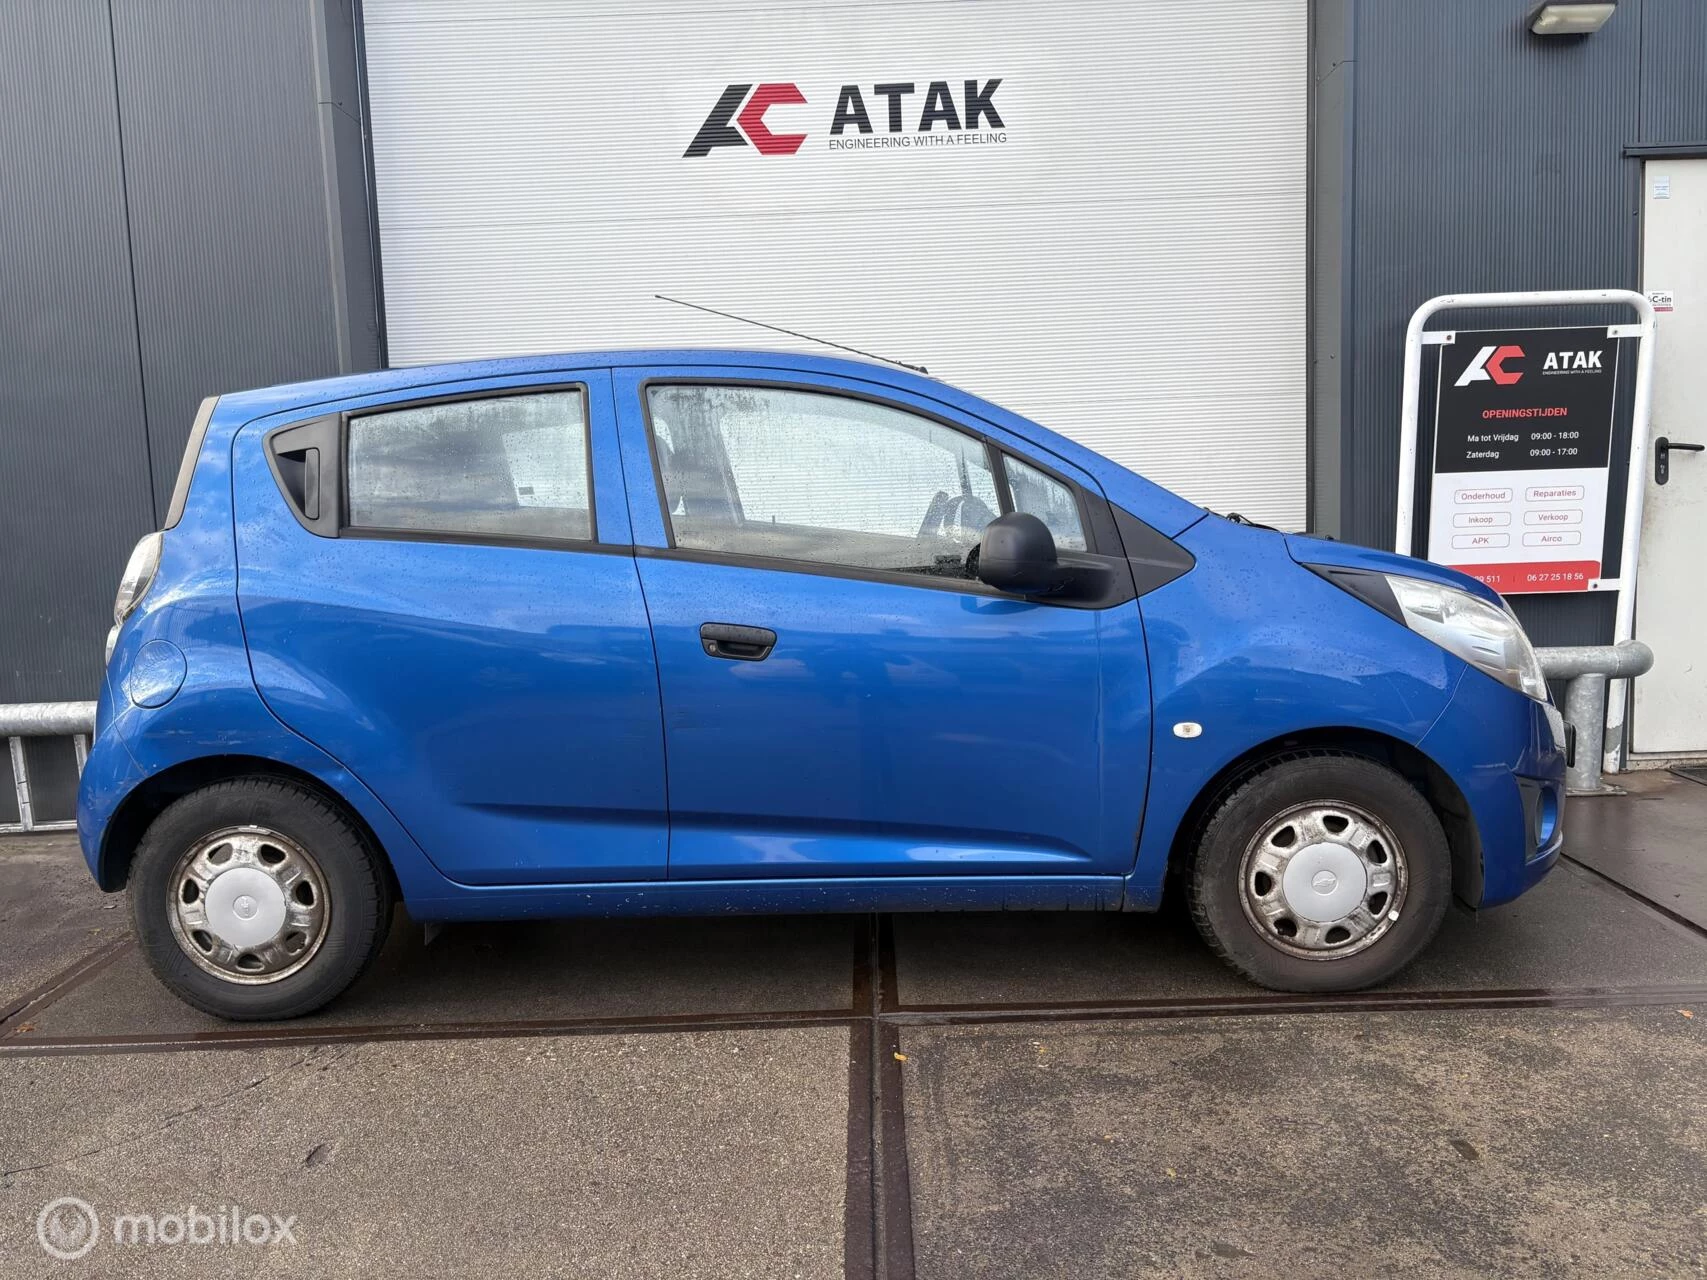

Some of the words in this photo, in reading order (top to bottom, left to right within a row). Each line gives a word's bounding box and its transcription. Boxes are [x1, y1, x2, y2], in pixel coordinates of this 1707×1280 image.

[830, 78, 1006, 135] ATAK
[829, 136, 911, 150] ENGINEERING
[914, 135, 944, 147] WITH
[946, 134, 956, 145] A
[957, 132, 1008, 144] FEELING
[1542, 350, 1603, 370] ATAK
[1482, 407, 1568, 419] OPENINGSTIJDEN
[1467, 434, 1479, 442] Ma
[1481, 434, 1491, 442] tot
[1493, 433, 1519, 443] Vrijdag
[1530, 432, 1552, 440] 09:00
[1558, 431, 1579, 439] 18:00
[1466, 450, 1500, 459] Zaterdag
[1529, 449, 1551, 457] 09:00
[1461, 491, 1506, 501] Onderhoud
[1533, 489, 1577, 499] Reparaties
[1468, 516, 1493, 524] Inkoop
[1538, 513, 1568, 522] Verkoop
[1472, 537, 1489, 545] APK
[1541, 535, 1563, 543] Airco
[1486, 575, 1500, 583] 511
[1526, 574, 1537, 582] 06
[1551, 573, 1561, 581] 25
